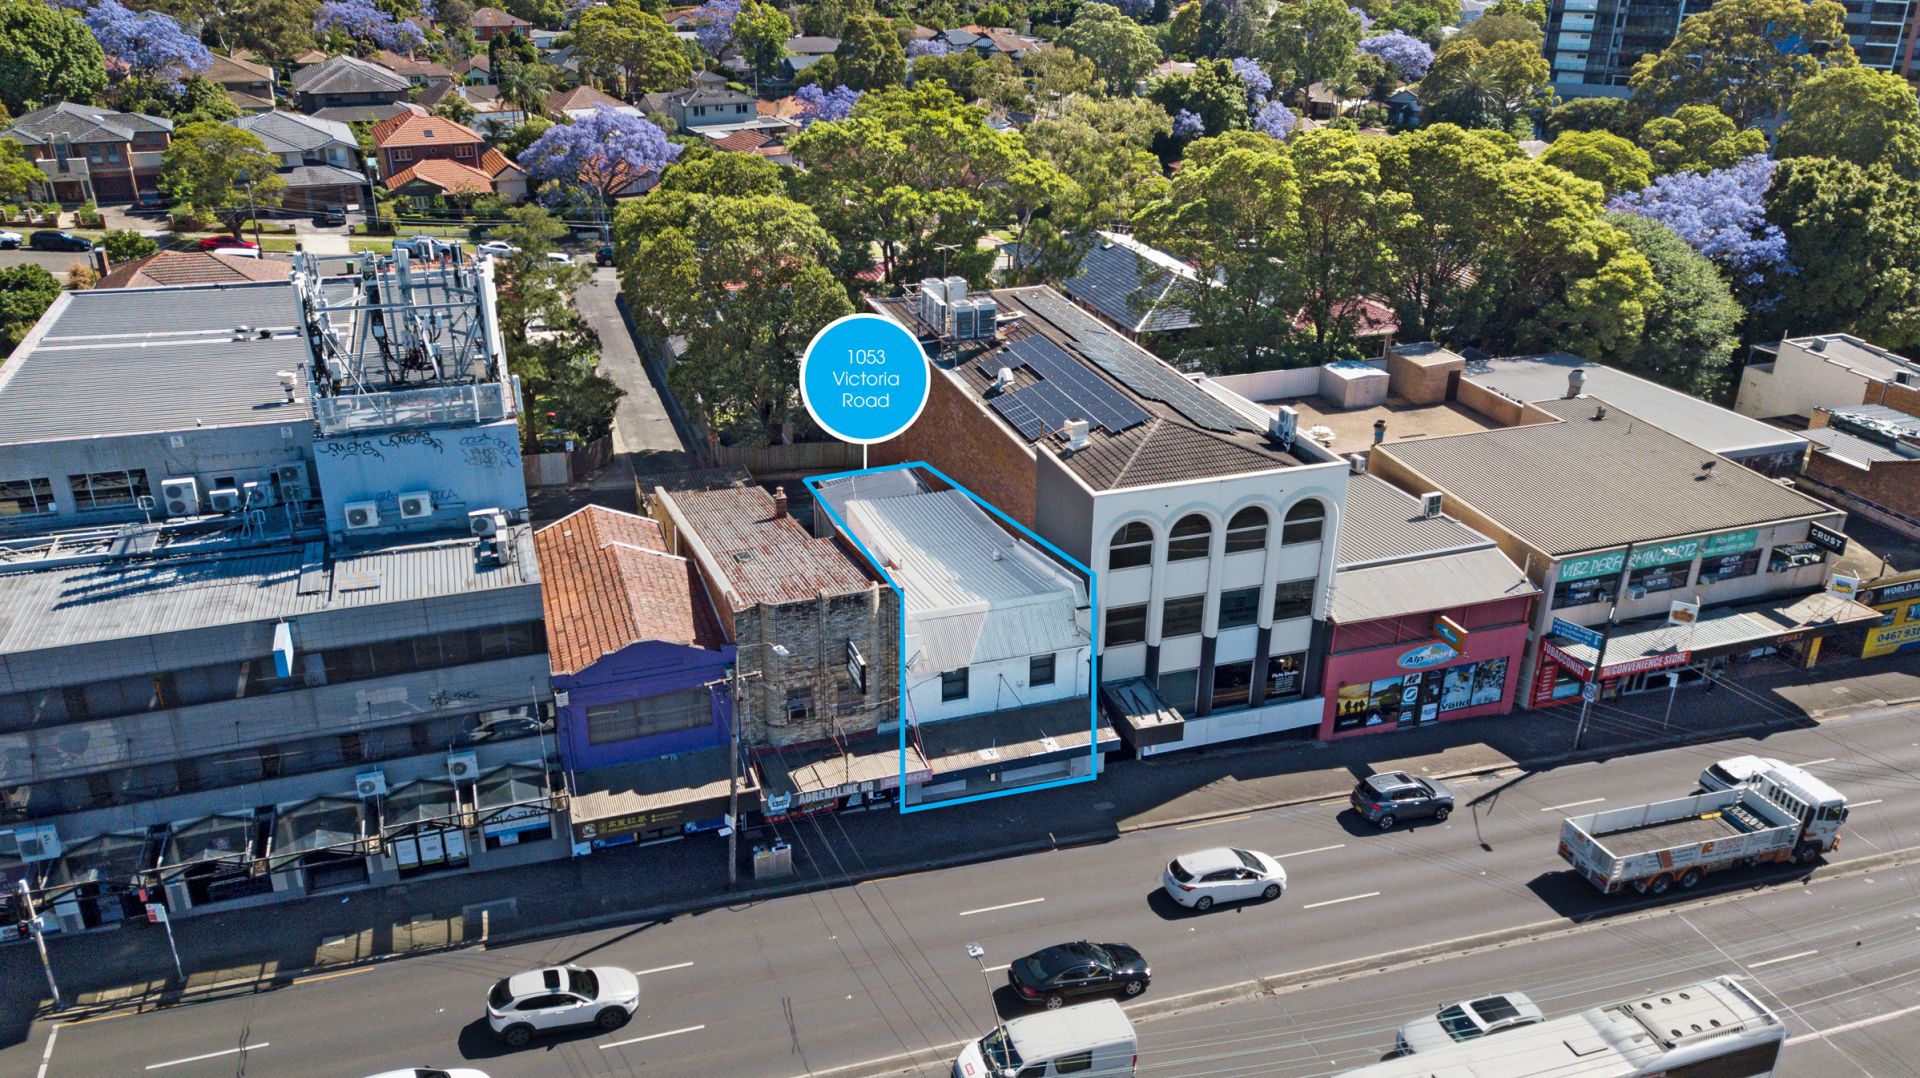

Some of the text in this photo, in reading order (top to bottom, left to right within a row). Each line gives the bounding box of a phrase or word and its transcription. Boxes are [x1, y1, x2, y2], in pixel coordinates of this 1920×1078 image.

[1811, 528, 1843, 548] CRUST
[1562, 560, 1589, 578] VIBZ
[1590, 548, 1665, 574] PERFRMING
[1884, 583, 1912, 595] WORLD
[1777, 632, 1805, 643] CRUST
[1544, 641, 1585, 676] TOBACCONIST
[1611, 656, 1664, 675] CONVENIENCE
[1664, 652, 1686, 665] STORE
[1405, 673, 1420, 685] K2
[798, 783, 859, 805] ADRENALINE
[861, 781, 874, 793] HQ
